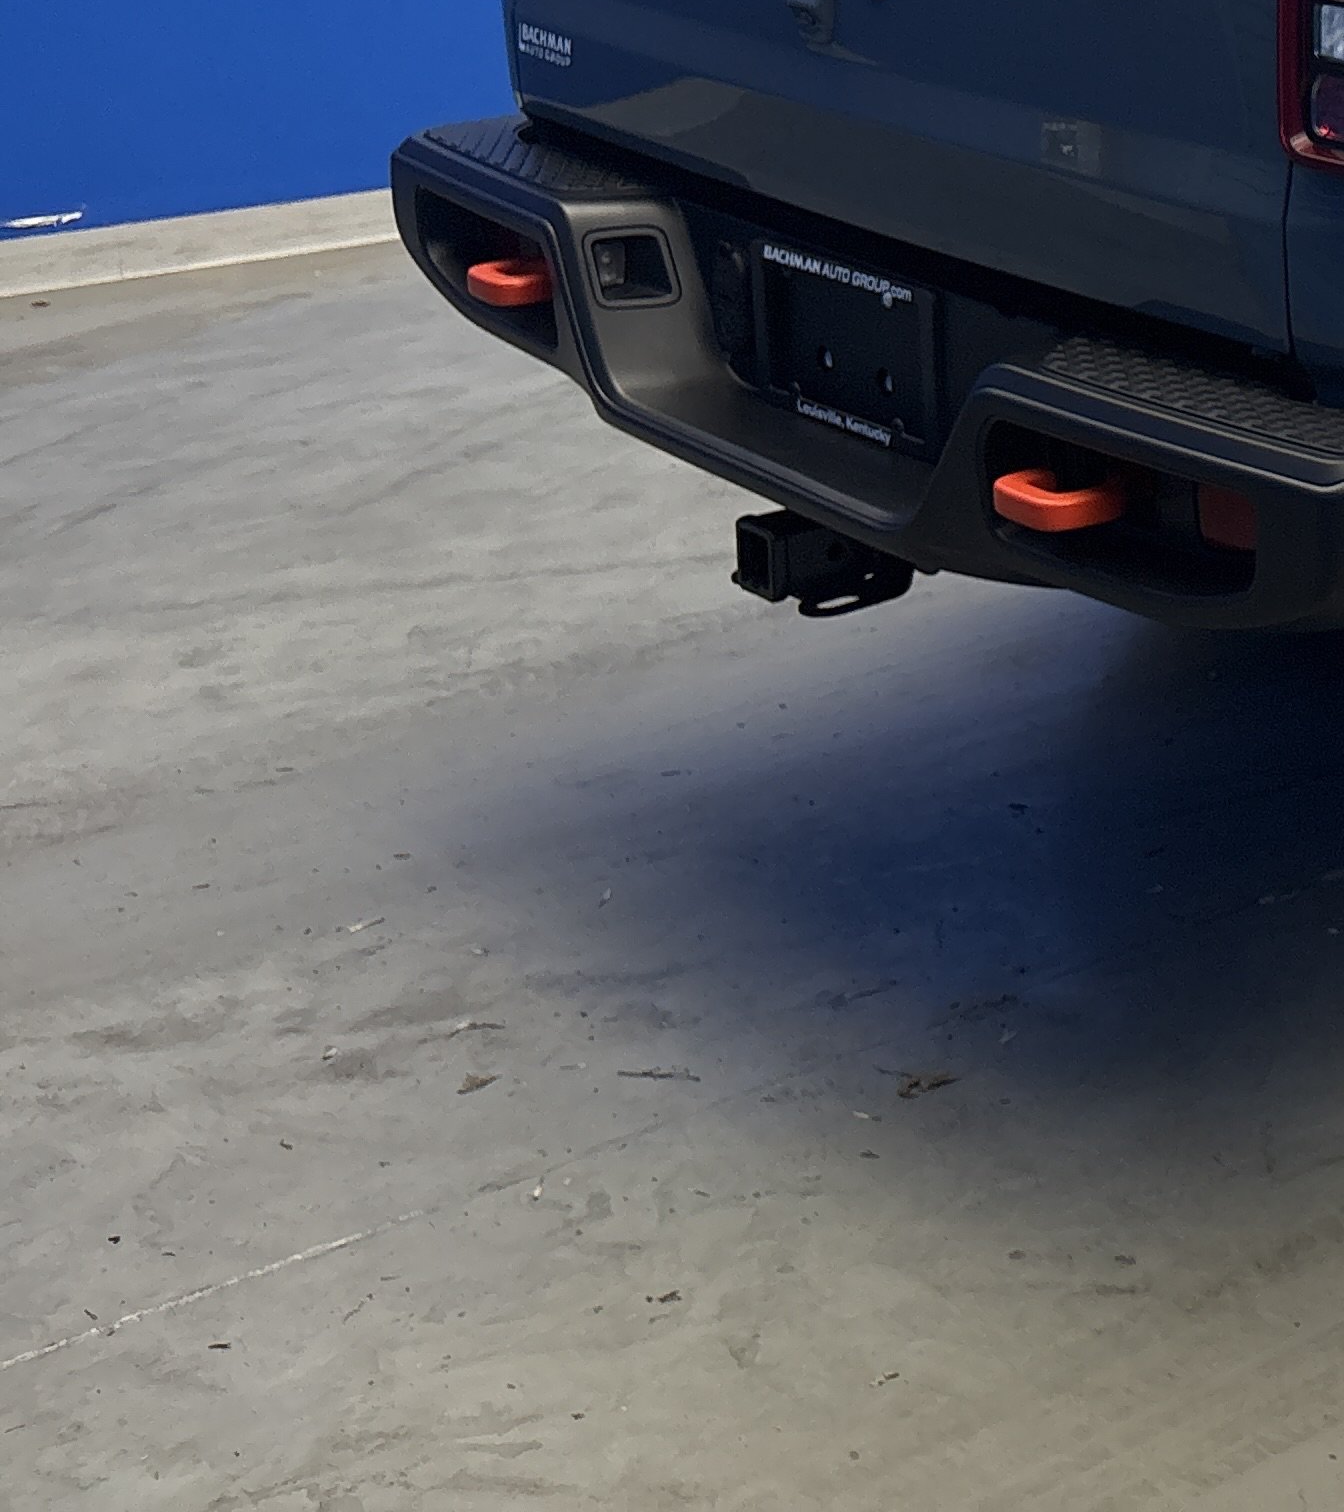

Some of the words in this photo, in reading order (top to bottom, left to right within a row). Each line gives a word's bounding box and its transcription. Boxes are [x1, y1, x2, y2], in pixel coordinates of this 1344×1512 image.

[522, 23, 572, 56] BACHMAN
[763, 244, 821, 275] BACHMAN
[822, 263, 851, 284] AUTO
[846, 415, 892, 447] Kentucky
